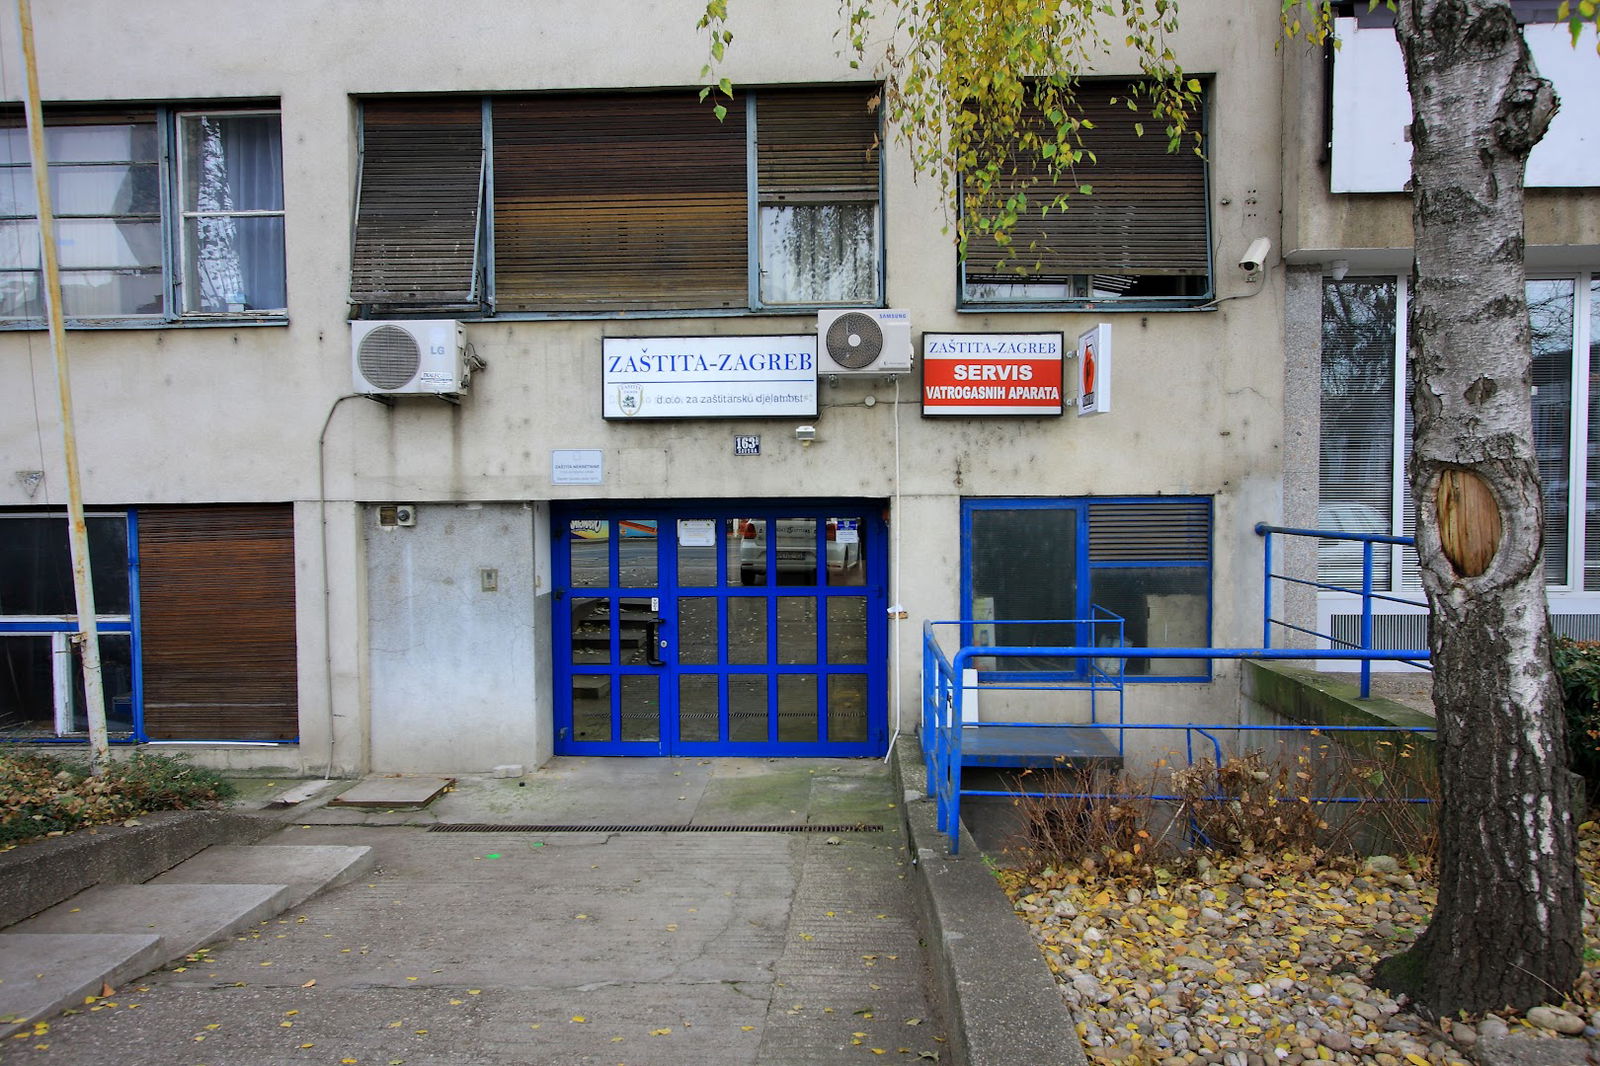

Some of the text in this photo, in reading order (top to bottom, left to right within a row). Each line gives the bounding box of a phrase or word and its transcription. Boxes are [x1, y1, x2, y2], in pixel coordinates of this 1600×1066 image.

[430, 346, 445, 355] LG
[929, 339, 1056, 354] ZAŠTITA-ZAGREB
[608, 348, 812, 373] ZAŠTITA-ZAGREB
[953, 364, 1033, 381] SERVIS
[686, 396, 699, 404] za
[925, 386, 1060, 400] VATROGASNIH APARATA
